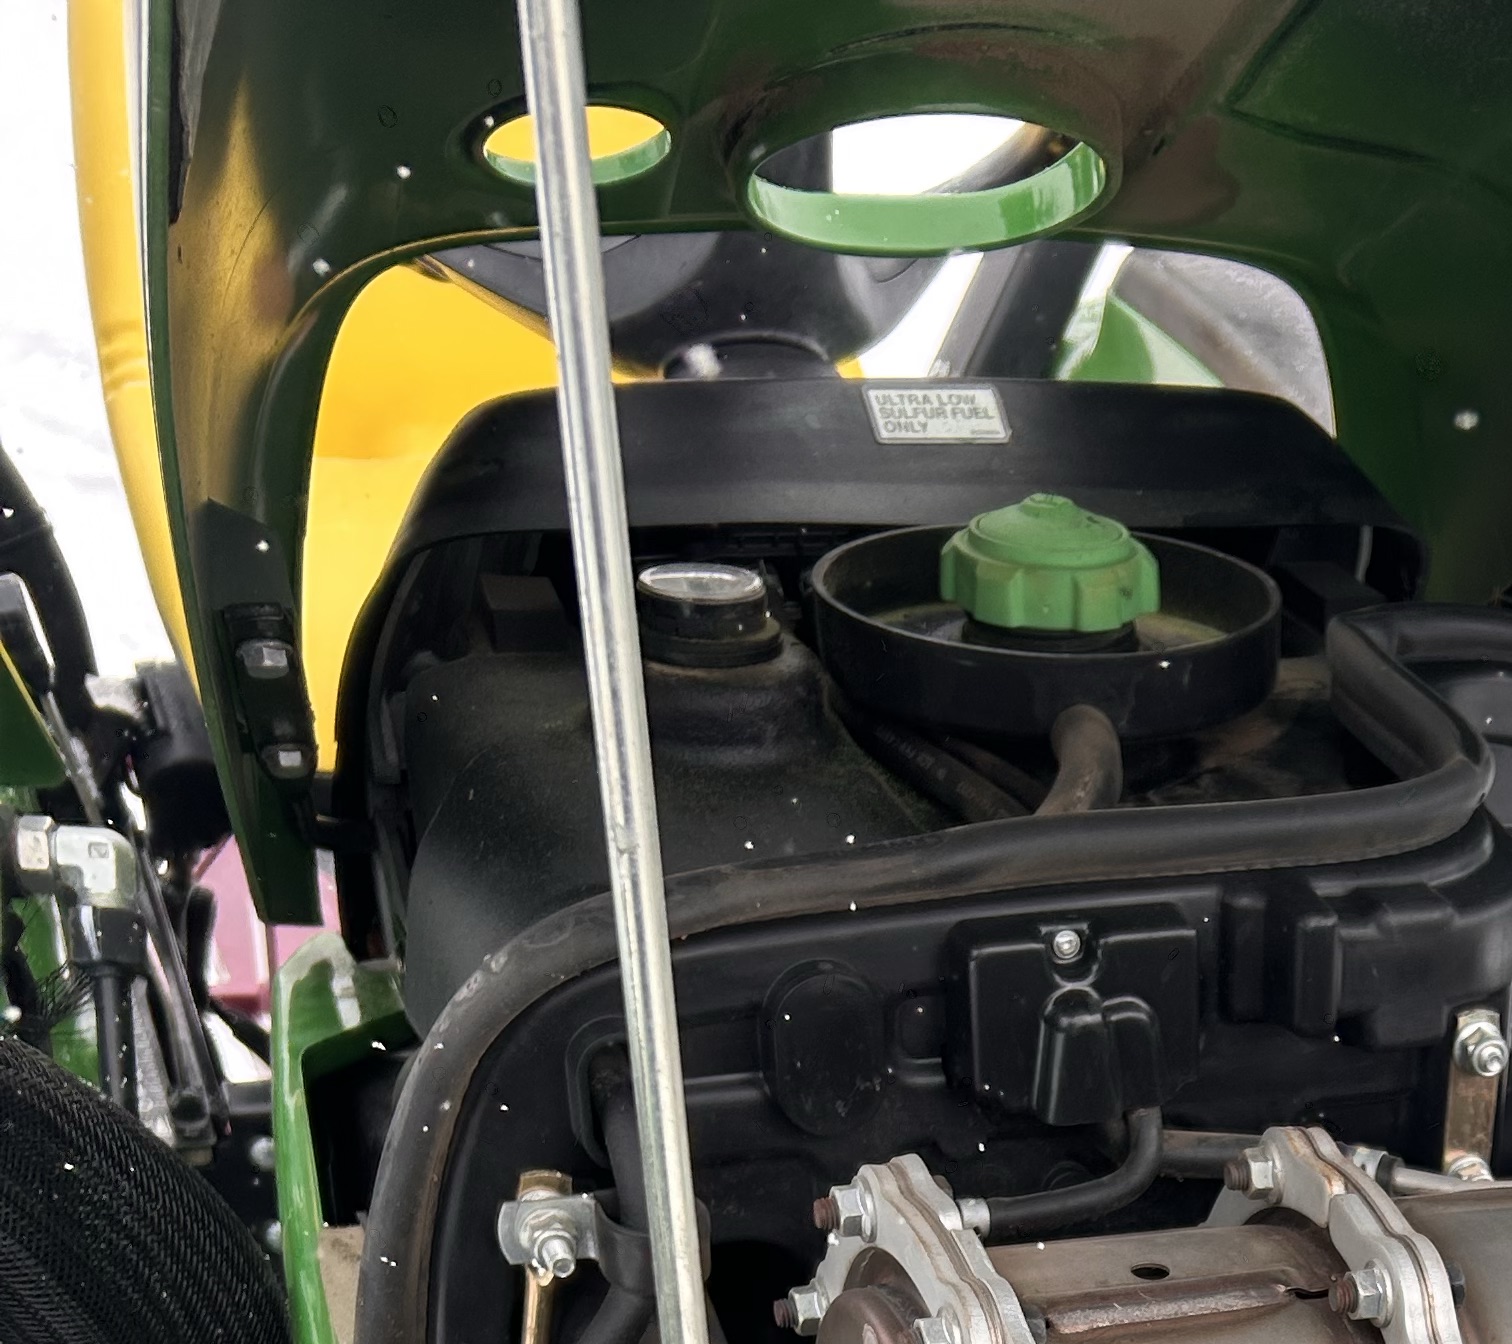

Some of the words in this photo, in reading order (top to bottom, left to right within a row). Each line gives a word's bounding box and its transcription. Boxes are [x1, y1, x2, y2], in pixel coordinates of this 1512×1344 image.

[875, 393, 933, 406] ULTRA
[936, 393, 976, 406] LOW
[878, 407, 948, 420] SULFUR
[951, 407, 994, 420] FUEL
[883, 420, 928, 433] ONLY
